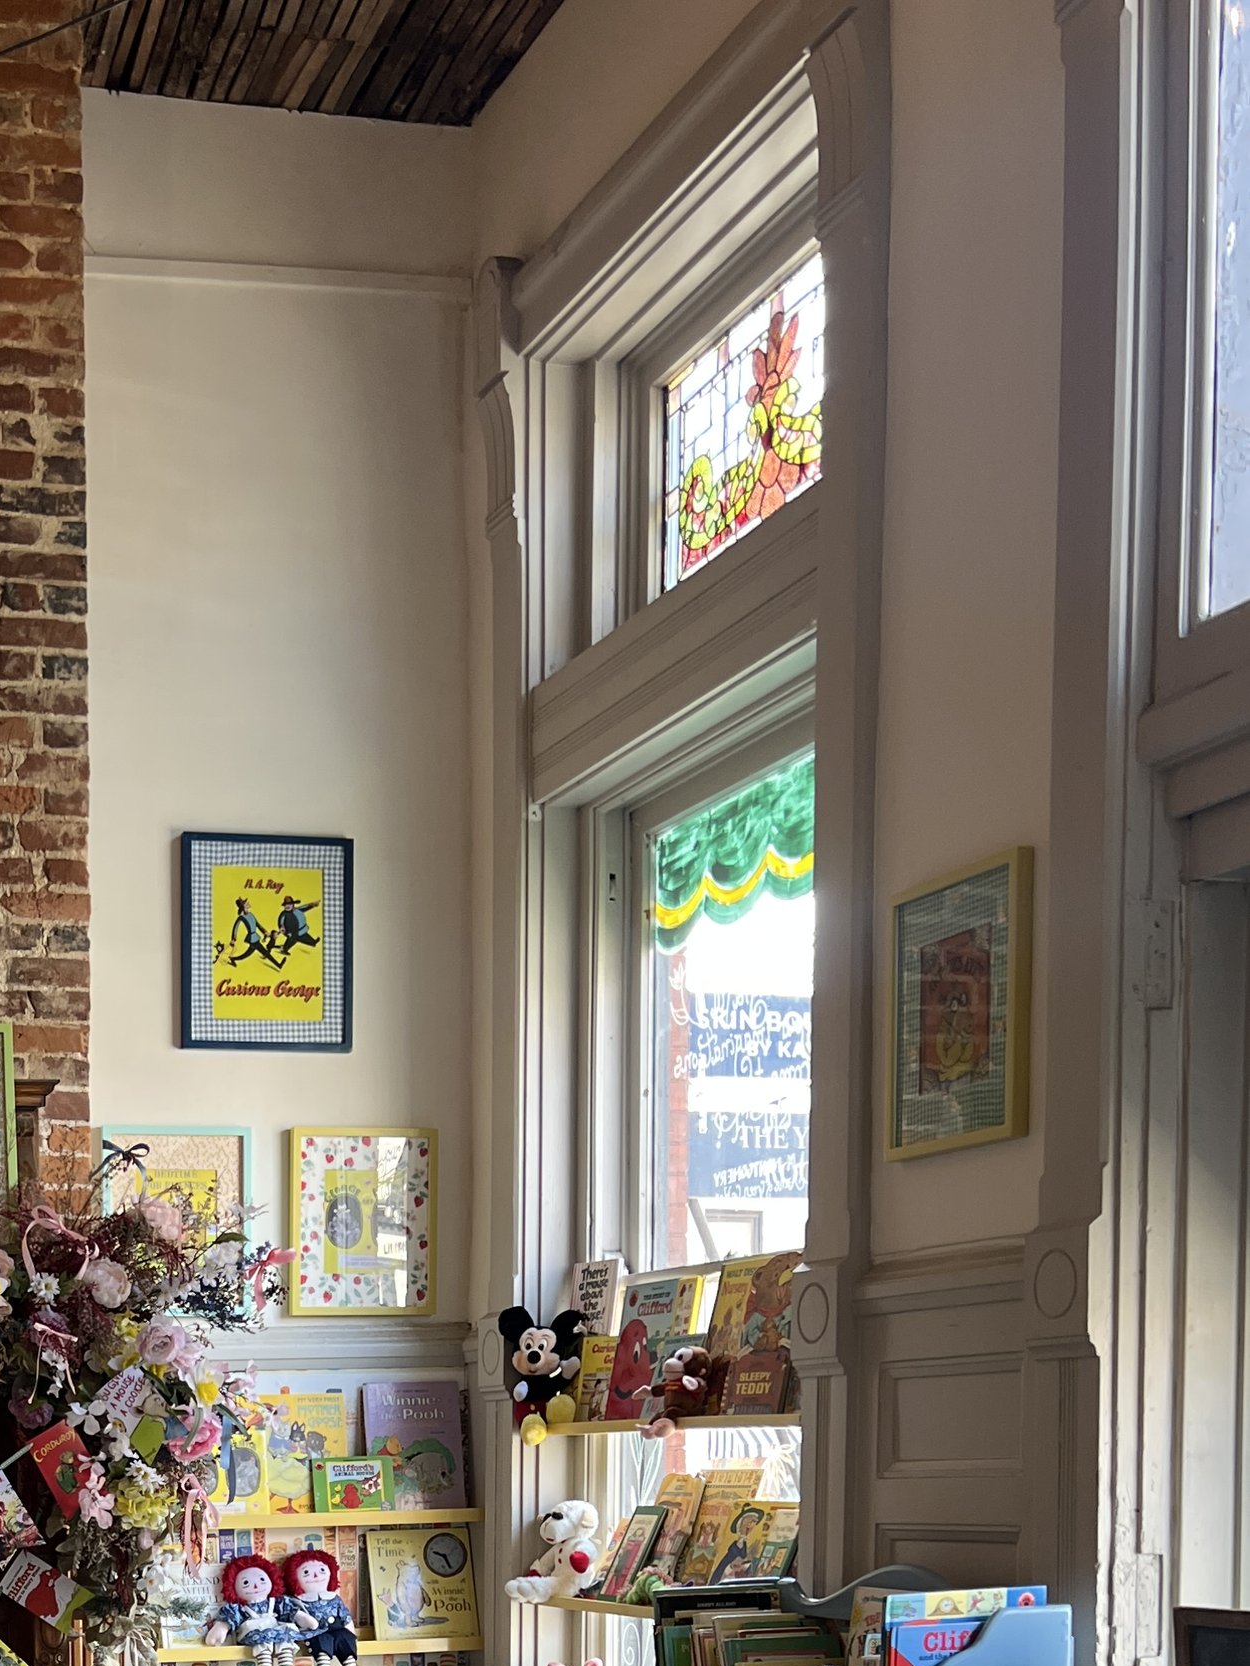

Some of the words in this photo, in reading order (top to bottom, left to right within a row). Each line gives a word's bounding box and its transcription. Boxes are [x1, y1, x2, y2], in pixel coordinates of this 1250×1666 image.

[216, 978, 271, 997] Curious
[273, 979, 321, 1003] George
[580, 1289, 604, 1301] about
[584, 1300, 599, 1311] the
[638, 1299, 673, 1316] Clifford
[739, 1371, 771, 1382] SLEEPY
[114, 1374, 135, 1403] MOUSE
[124, 1376, 147, 1408] COOKIE
[735, 1382, 772, 1395] TEDDY
[403, 1408, 446, 1420] Pooh
[33, 1429, 78, 1463] CORDUROY
[431, 1587, 465, 1596] Winnie
[434, 1600, 472, 1613] Pooh
[923, 1629, 972, 1653] Clif
